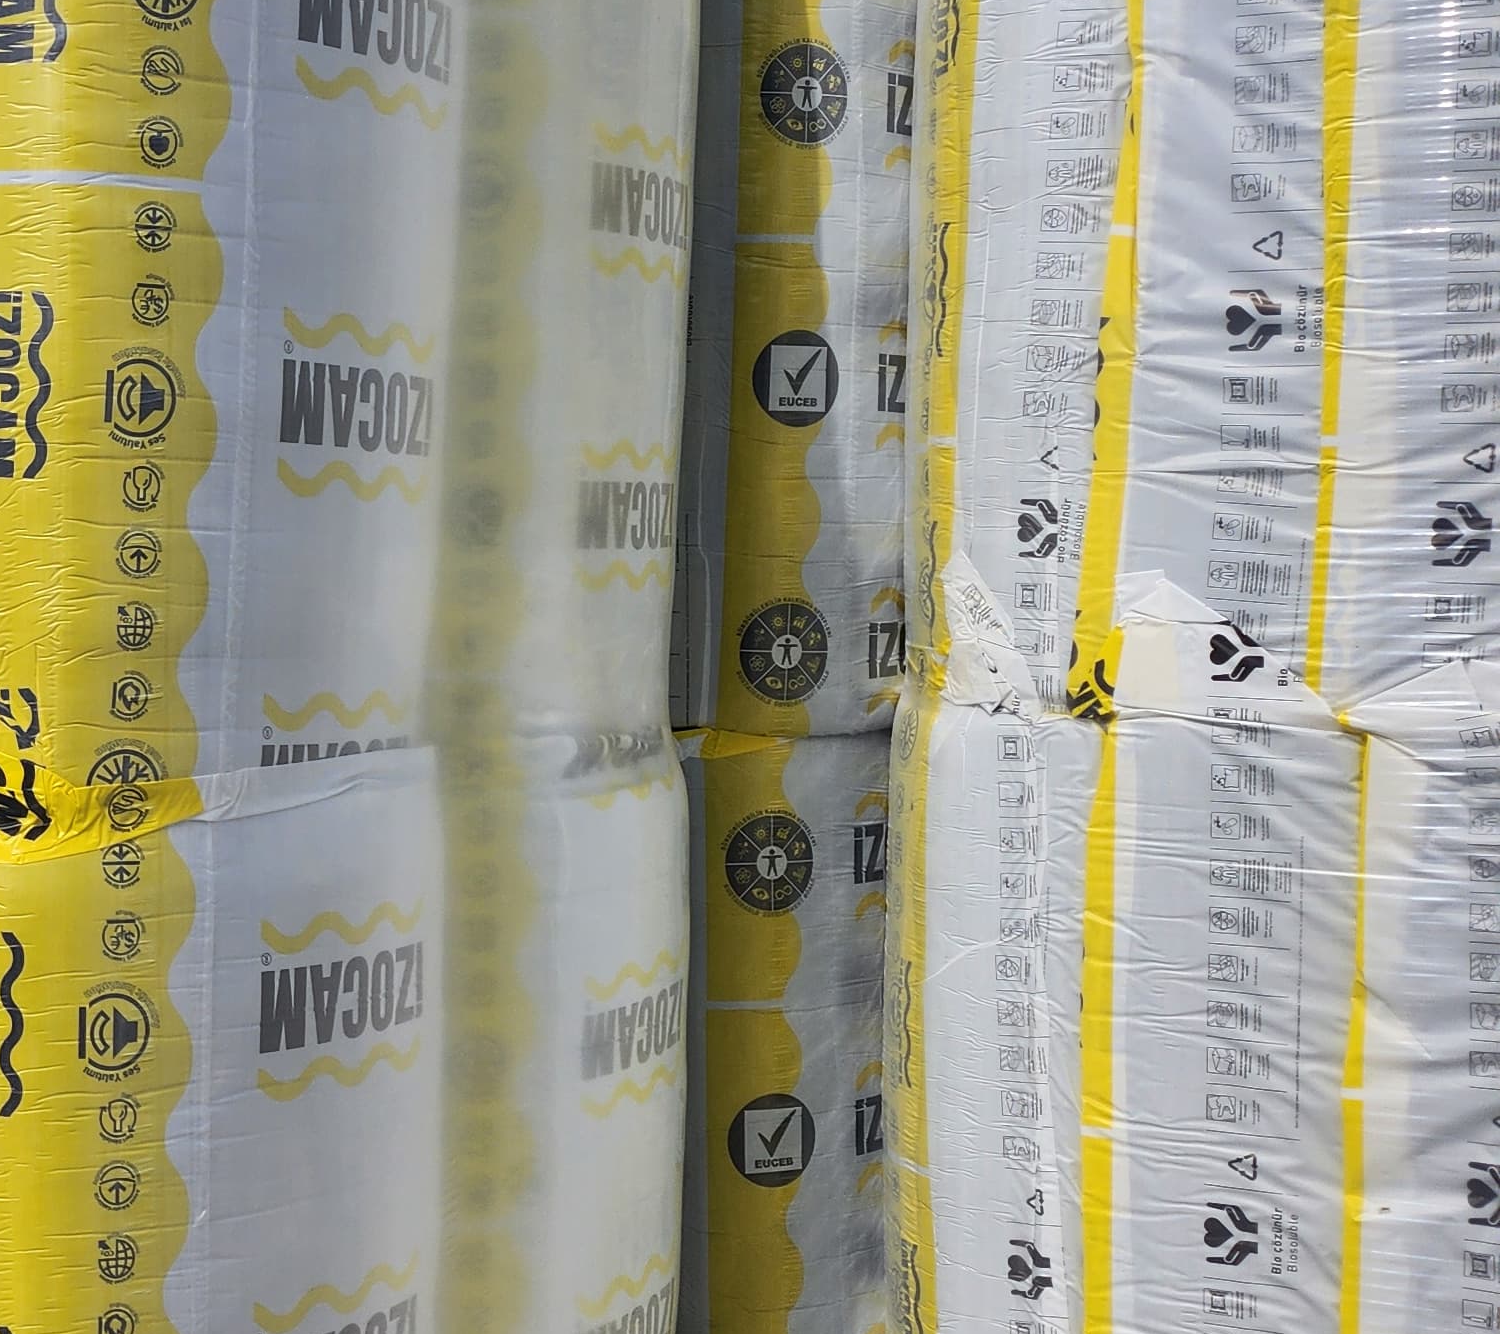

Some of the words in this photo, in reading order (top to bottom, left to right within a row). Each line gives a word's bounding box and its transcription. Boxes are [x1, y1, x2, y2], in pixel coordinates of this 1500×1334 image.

[141, 13, 179, 31] Yalıtımı
[1296, 285, 1308, 331] çözünür
[1294, 334, 1305, 352] Bio
[779, 397, 817, 407] EUCEB
[108, 430, 146, 449] Yalıtımı
[148, 433, 166, 446] Ses
[1058, 498, 1072, 542] çözünür
[1070, 504, 1086, 560] Biosoluble
[1277, 669, 1288, 686] Bio
[83, 1065, 121, 1082] Yalıtımı
[123, 1064, 141, 1077] Ses
[755, 1157, 793, 1168] EUCEB
[1272, 1207, 1283, 1253] çözünür
[1287, 1215, 1298, 1272] Biosoluble
[1271, 1257, 1282, 1274] Bio
